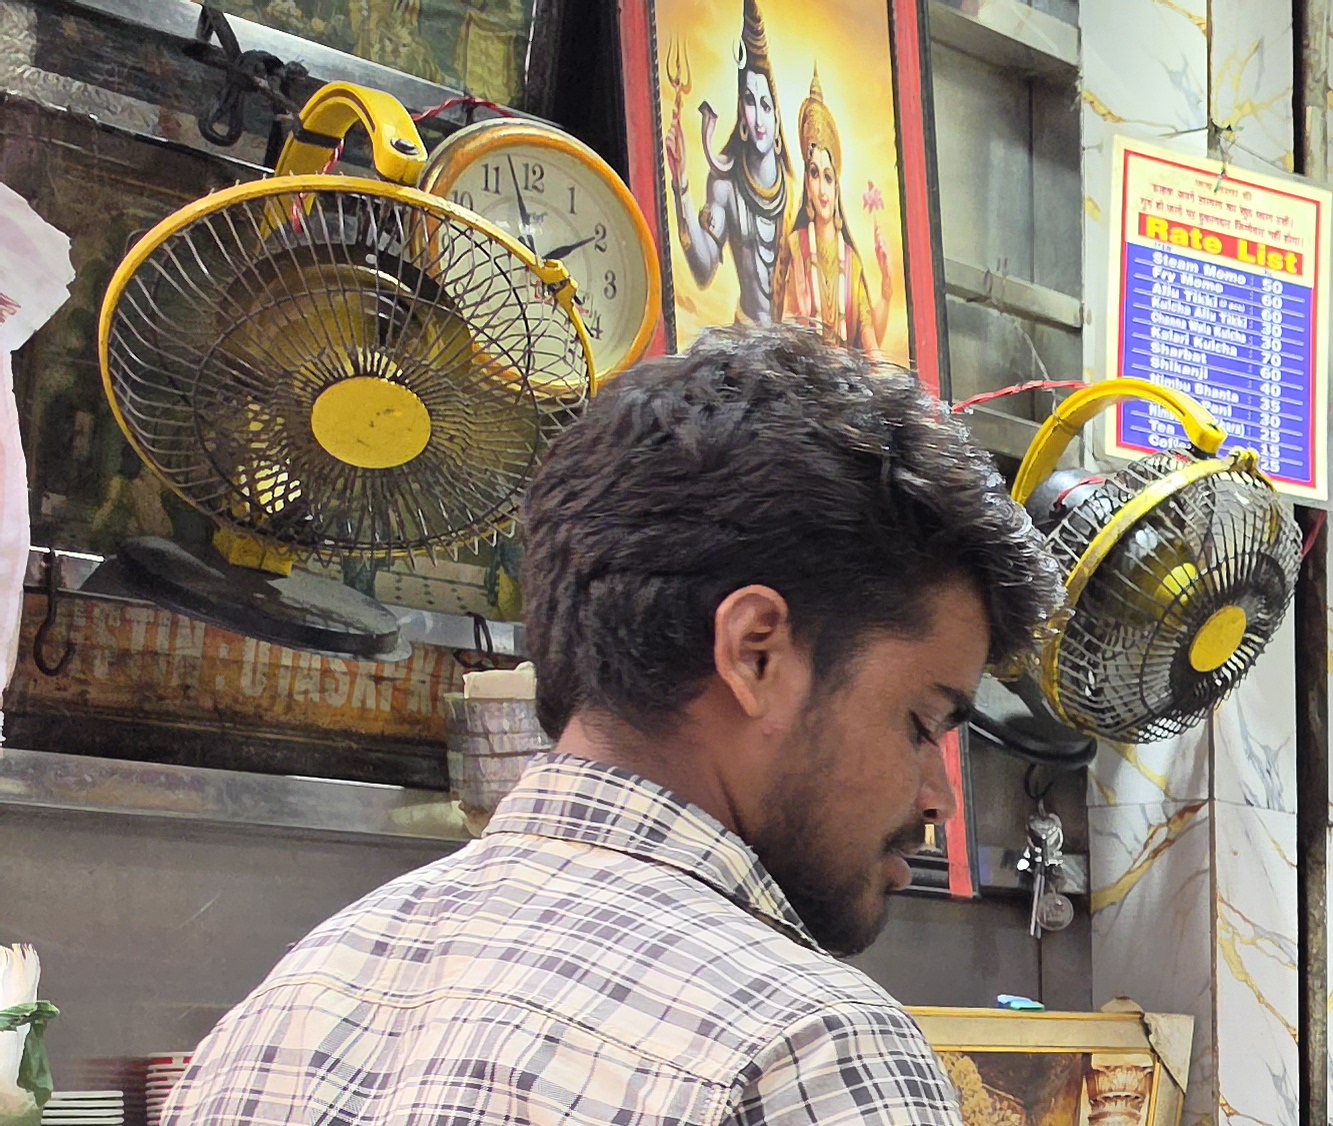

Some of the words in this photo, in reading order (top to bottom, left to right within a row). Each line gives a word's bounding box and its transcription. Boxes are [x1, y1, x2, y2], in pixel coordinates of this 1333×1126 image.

[481, 163, 500, 195] 11
[522, 162, 545, 194] 12
[568, 185, 577, 215] 1
[594, 223, 608, 253] 2
[1145, 215, 1223, 255] Rate
[1236, 238, 1298, 275] List
[604, 270, 617, 299] 3
[1151, 265, 1177, 285] Fry
[1180, 272, 1224, 294] Momo
[1261, 294, 1283, 310] 60
[1152, 251, 1199, 274] Steam
[1202, 263, 1247, 286] Momo
[1261, 277, 1284, 295] 50
[1151, 296, 1192, 316] Kulcha
[1260, 322, 1283, 338] 30
[1150, 340, 1207, 364] Sharbat
[1260, 366, 1281, 382] 60
[1193, 336, 1238, 357] Kulcha
[1260, 351, 1282, 367] 70
[1260, 337, 1282, 353] 30
[1149, 356, 1209, 381] Shikanji
[1259, 382, 1282, 398] 40
[1149, 372, 1191, 393] Nimbu
[1259, 397, 1280, 413] 35
[1259, 413, 1281, 429] 30
[1259, 428, 1280, 443] 25
[1259, 459, 1280, 473] 25
